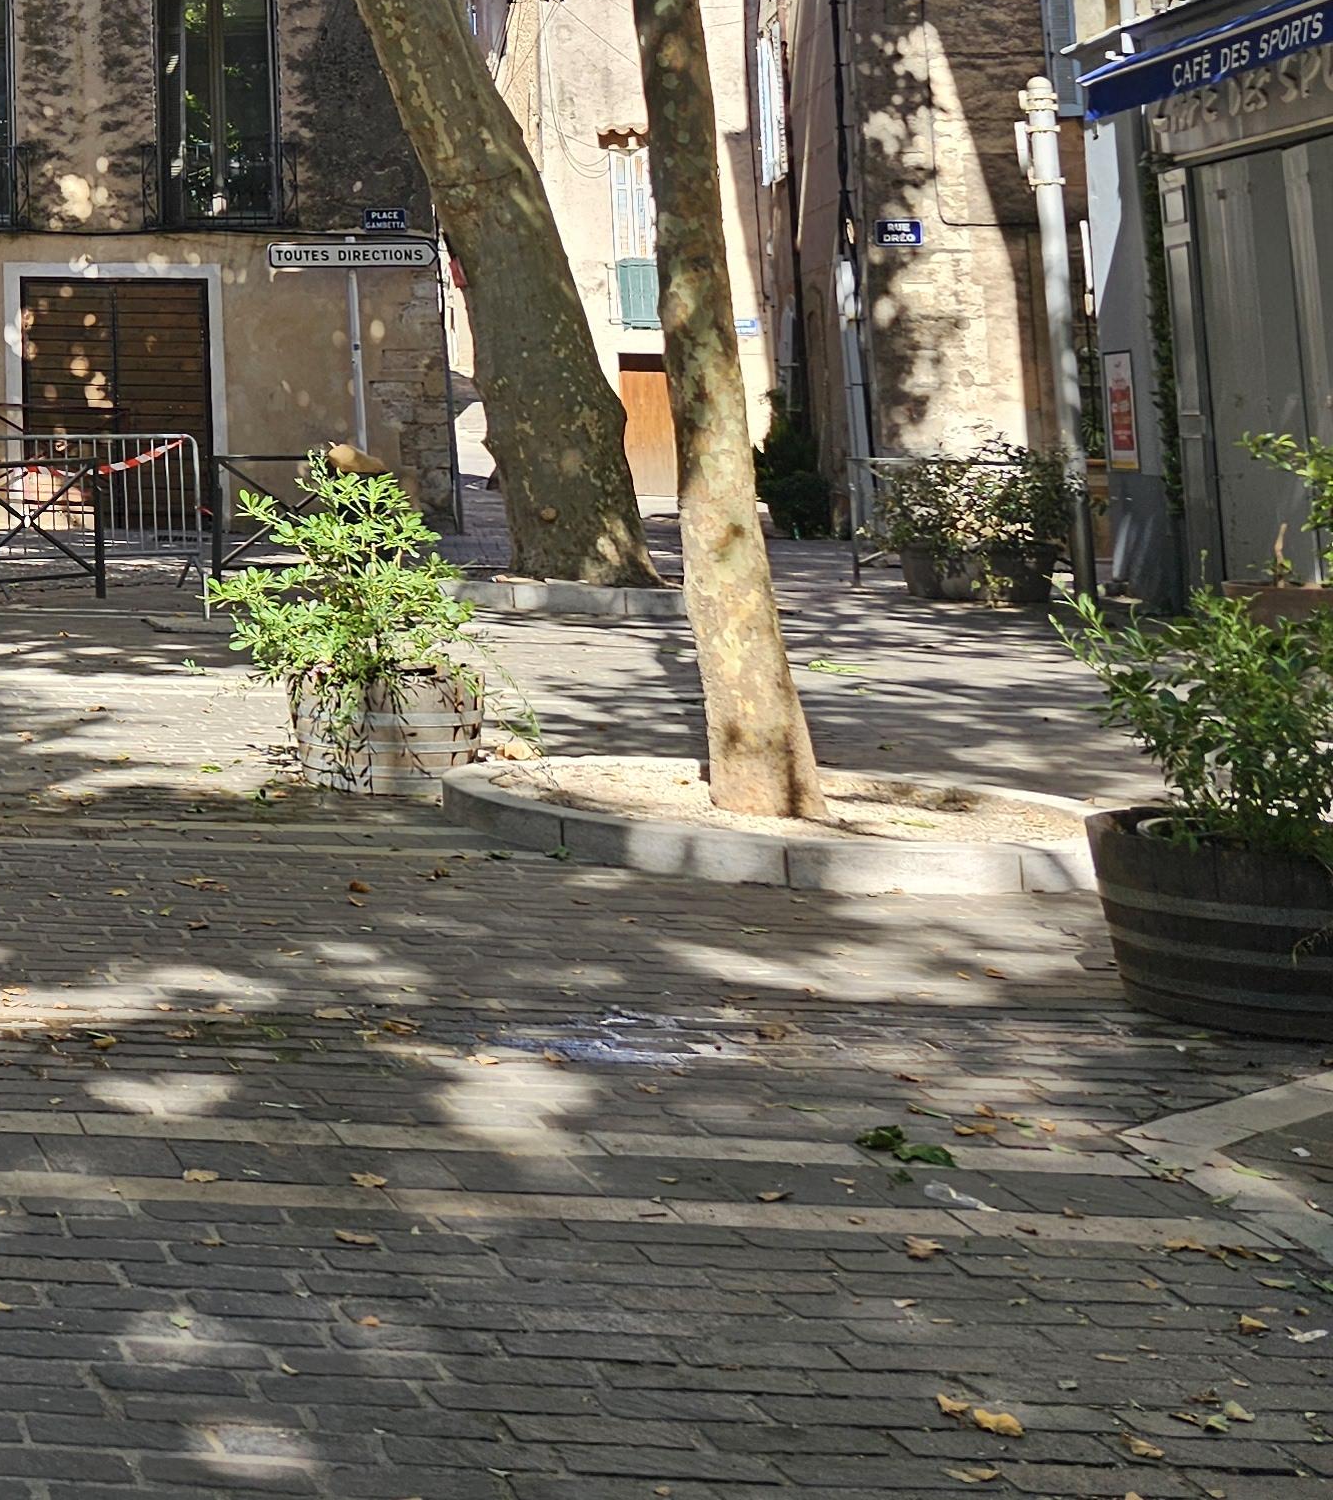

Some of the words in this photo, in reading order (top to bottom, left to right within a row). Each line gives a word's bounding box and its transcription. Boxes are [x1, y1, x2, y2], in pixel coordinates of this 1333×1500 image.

[1172, 50, 1212, 87] CAFÉ
[1220, 41, 1250, 73] DES
[1257, 12, 1324, 59] SPORTS
[371, 211, 399, 220] PLACE
[887, 223, 911, 232] RUE
[276, 250, 330, 261] TOUTES
[338, 250, 424, 261] DIRECTIONS
